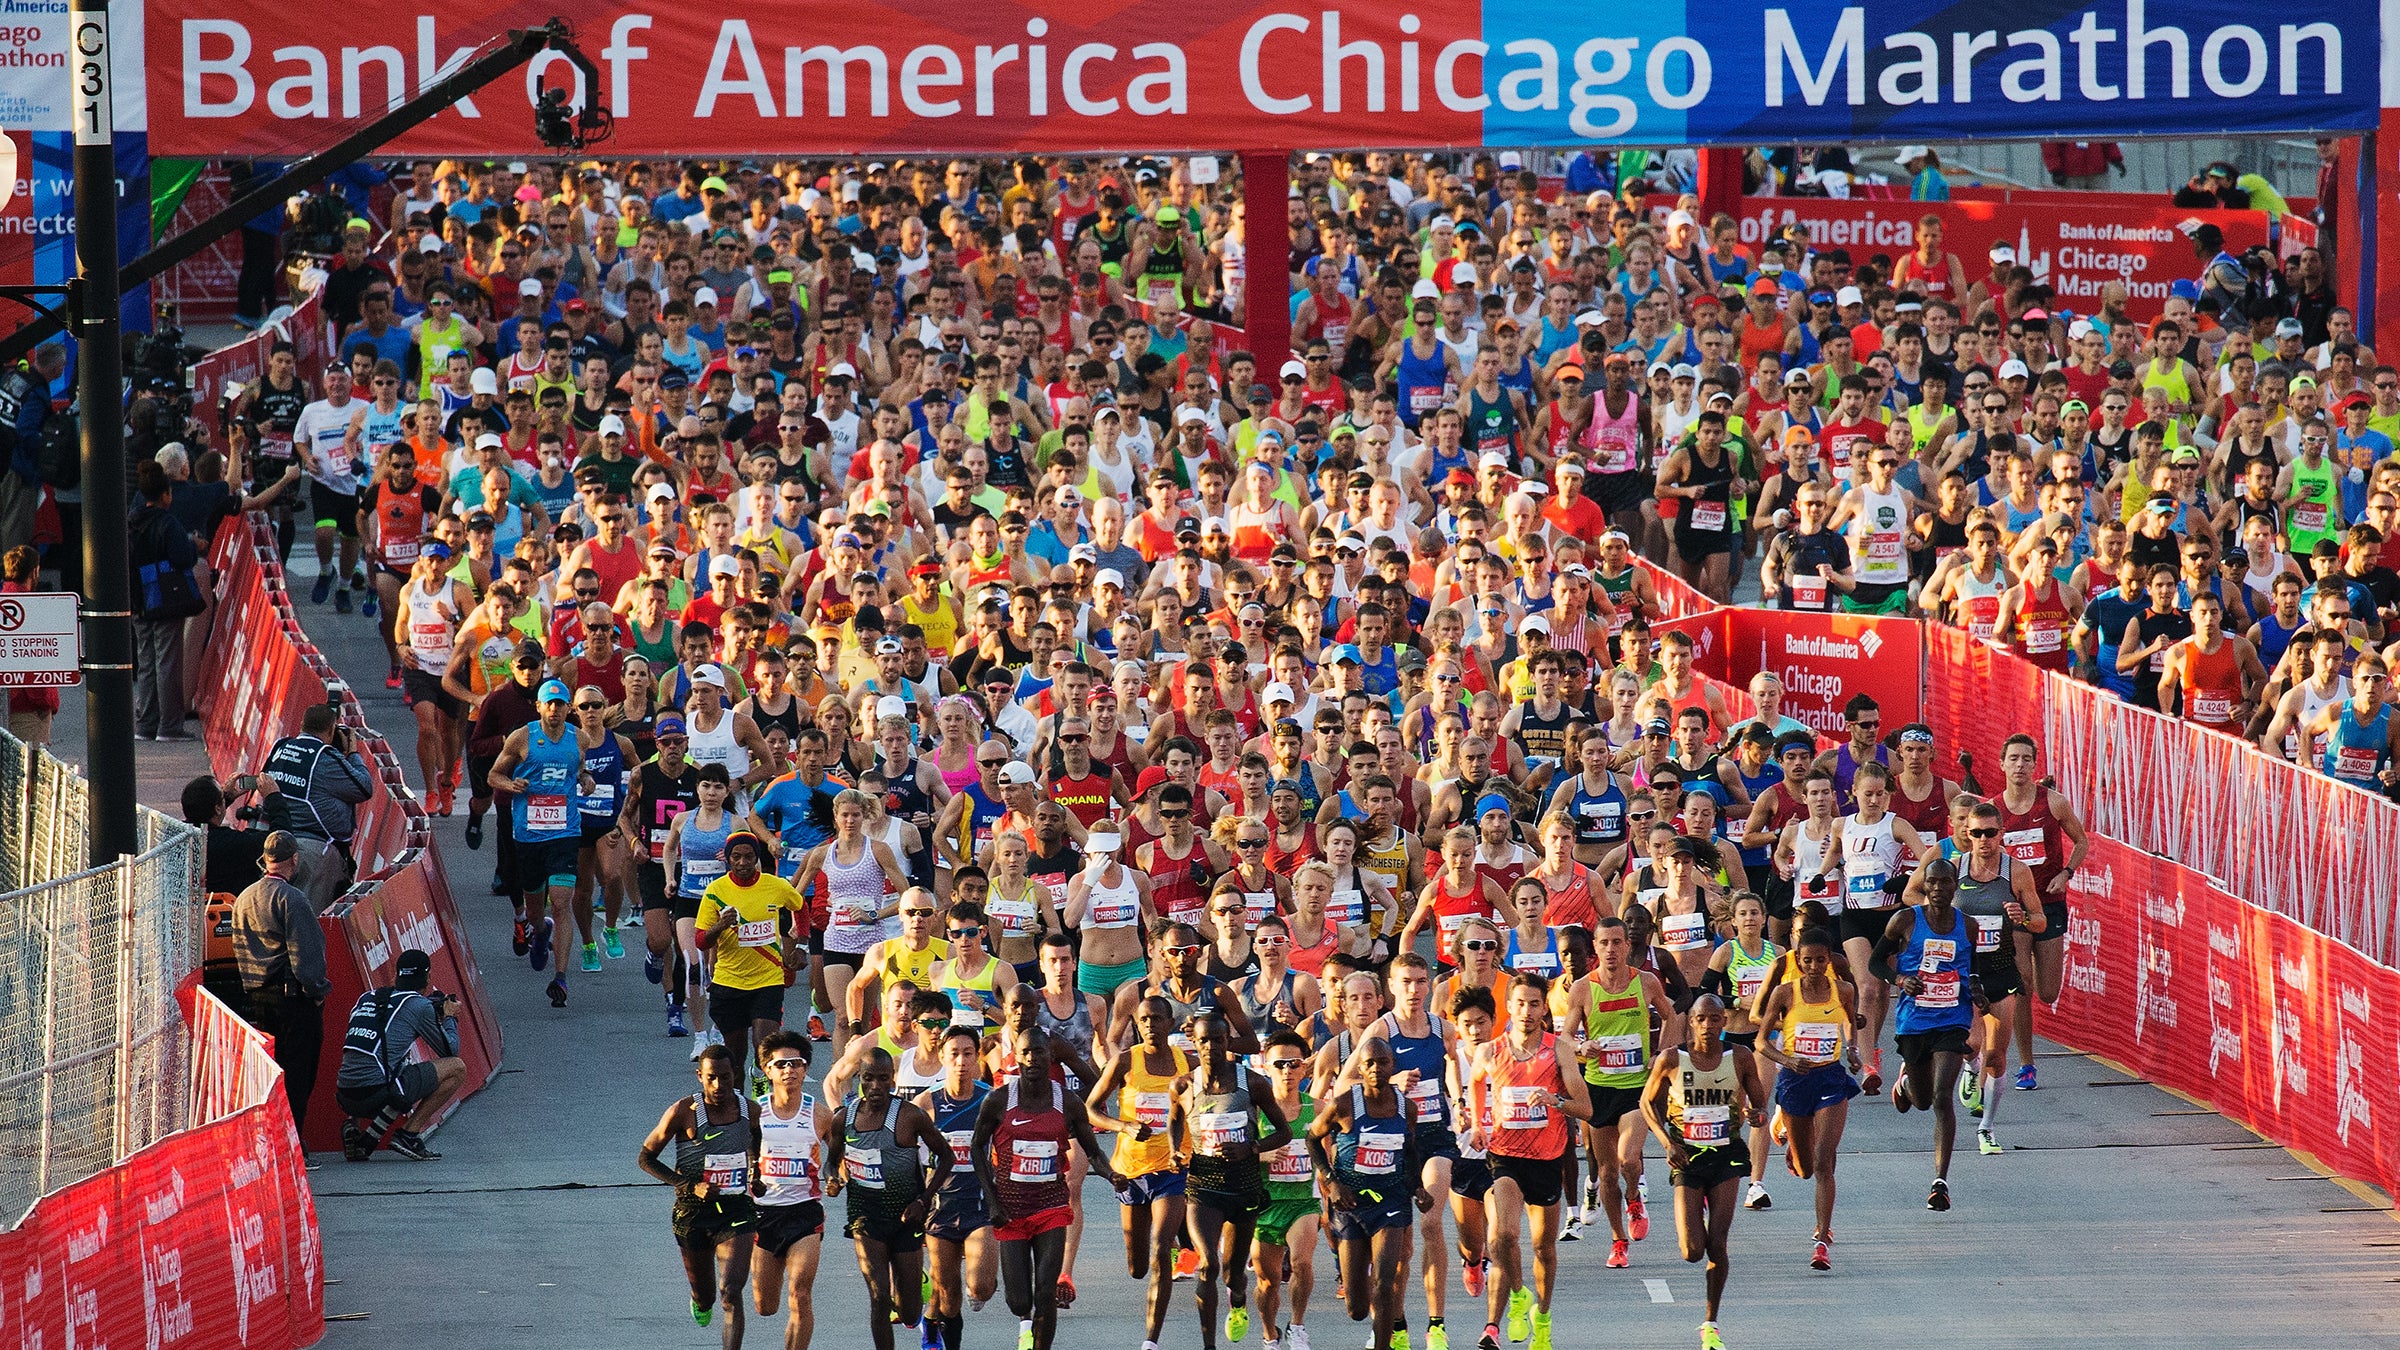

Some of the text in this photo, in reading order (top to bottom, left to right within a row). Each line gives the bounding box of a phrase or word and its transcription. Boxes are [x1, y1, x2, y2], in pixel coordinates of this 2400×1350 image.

[5, 1, 68, 13] America
[182, 4, 2343, 138] Bank of America Chicago Marathon
[1740, 209, 1776, 243] of
[2060, 222, 2174, 243] Bank of America
[2058, 247, 2147, 276] Chicago
[2058, 274, 2168, 298] Marhon
[1802, 591, 1816, 601] 321
[12, 638, 58, 648] STOPPING
[1785, 633, 1859, 660] Bank of America
[12, 648, 59, 659] STANDING
[33, 673, 73, 686] ZONE
[1785, 665, 1842, 703] Chicago
[2206, 702, 2226, 713] 4242
[1785, 701, 1846, 732] Maratho
[2350, 760, 2371, 771] 4069
[1055, 795, 1105, 806] ROMANIA
[535, 808, 560, 819] A 673
[1592, 817, 1619, 830] OODY
[2016, 846, 2034, 857] 313
[1360, 858, 1405, 869] ANCHESTER
[1859, 877, 1875, 889] 444
[1095, 909, 1134, 921] CHRISMAN
[1665, 929, 1705, 943] CROUCH
[1976, 931, 2001, 944] LLIS
[1931, 983, 1954, 996] 4295
[1795, 1040, 1837, 1054] MELESE
[1607, 1051, 1637, 1066] MOTT
[1684, 1089, 1735, 1105] ARMY
[1417, 1099, 1441, 1112] EDRA
[1503, 1106, 1547, 1118] ESTRADA
[1204, 1129, 1246, 1145] SAMBU
[1691, 1124, 1724, 1138] KIBET
[1020, 1157, 1051, 1173] KIRUI
[1365, 1150, 1395, 1166] KOGO
[766, 1160, 804, 1176] ISHIDA
[1270, 1158, 1313, 1173] GOKAYA
[710, 1171, 742, 1186] AYELE
